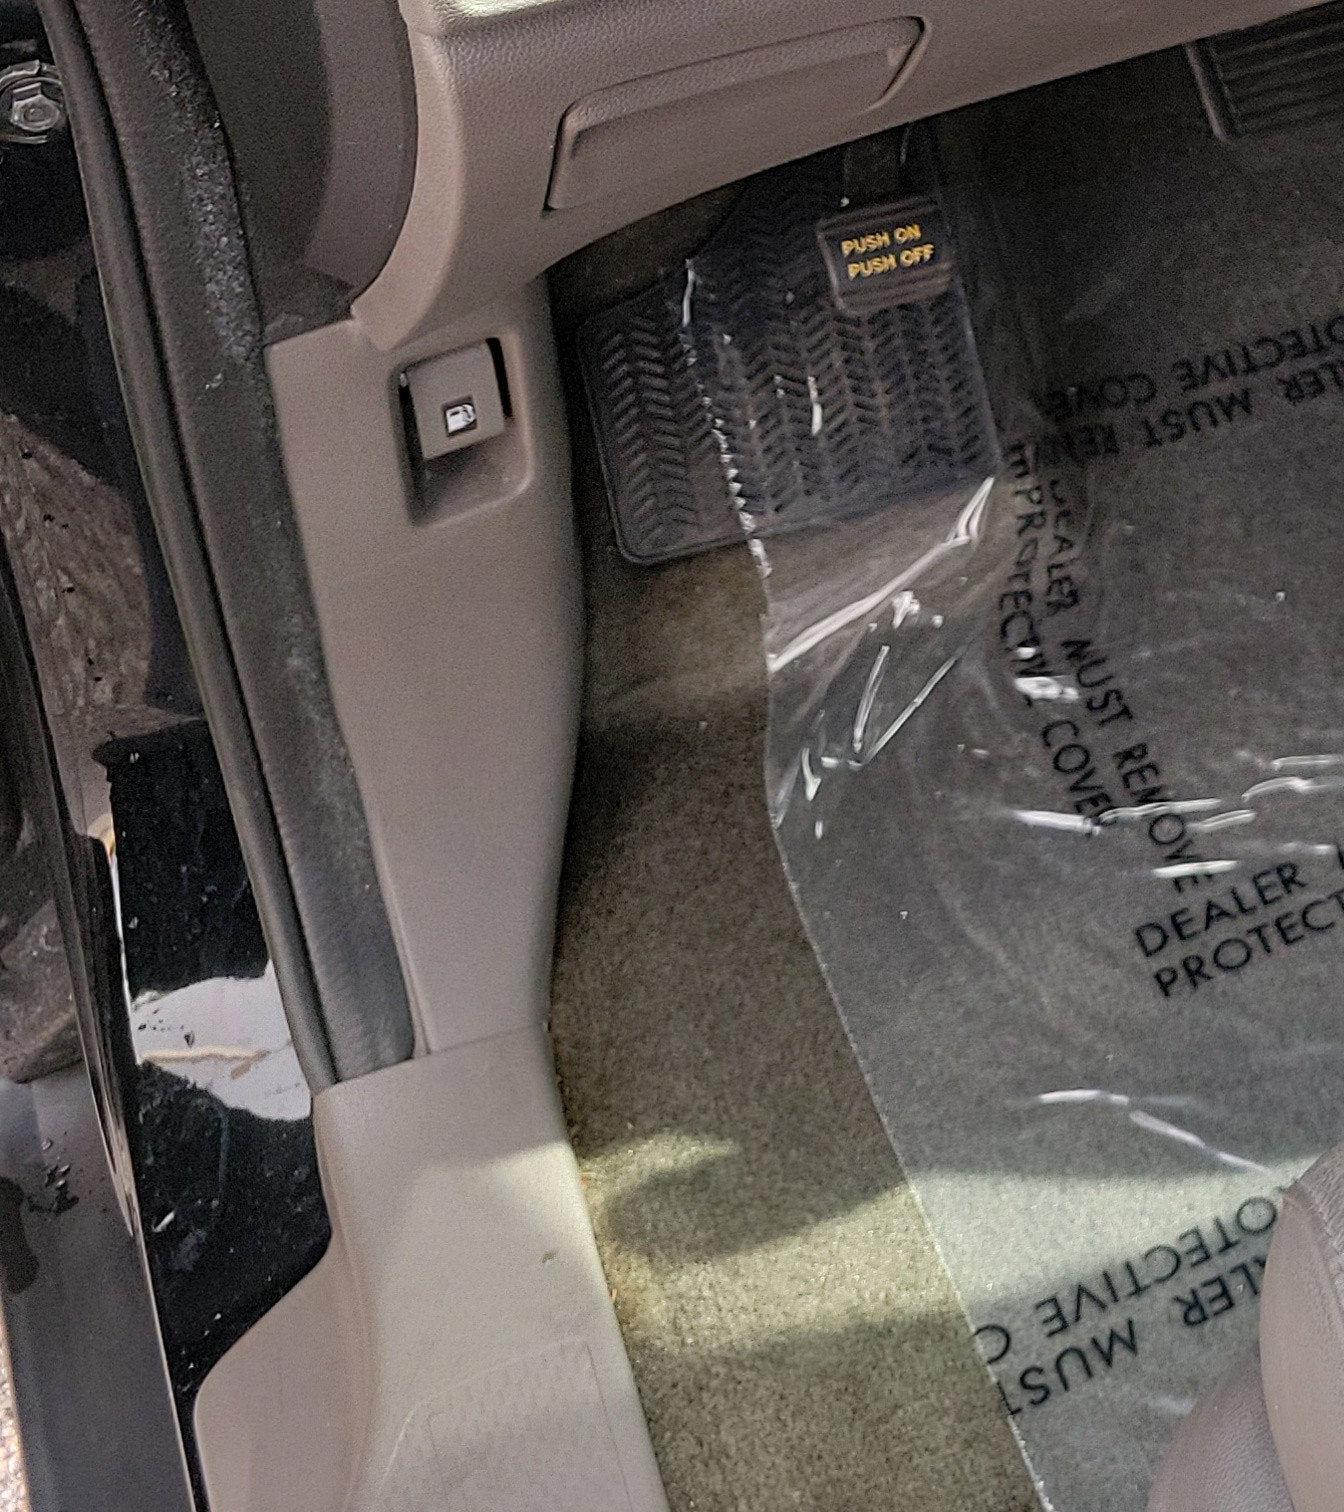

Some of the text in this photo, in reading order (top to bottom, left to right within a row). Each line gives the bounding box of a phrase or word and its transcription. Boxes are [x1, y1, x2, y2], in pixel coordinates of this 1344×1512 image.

[842, 224, 921, 256] PUSH ON
[848, 244, 934, 279] PUSH OFF
[1144, 388, 1252, 447] MUST
[1061, 636, 1134, 728] MUST
[1134, 861, 1304, 959] DEALER
